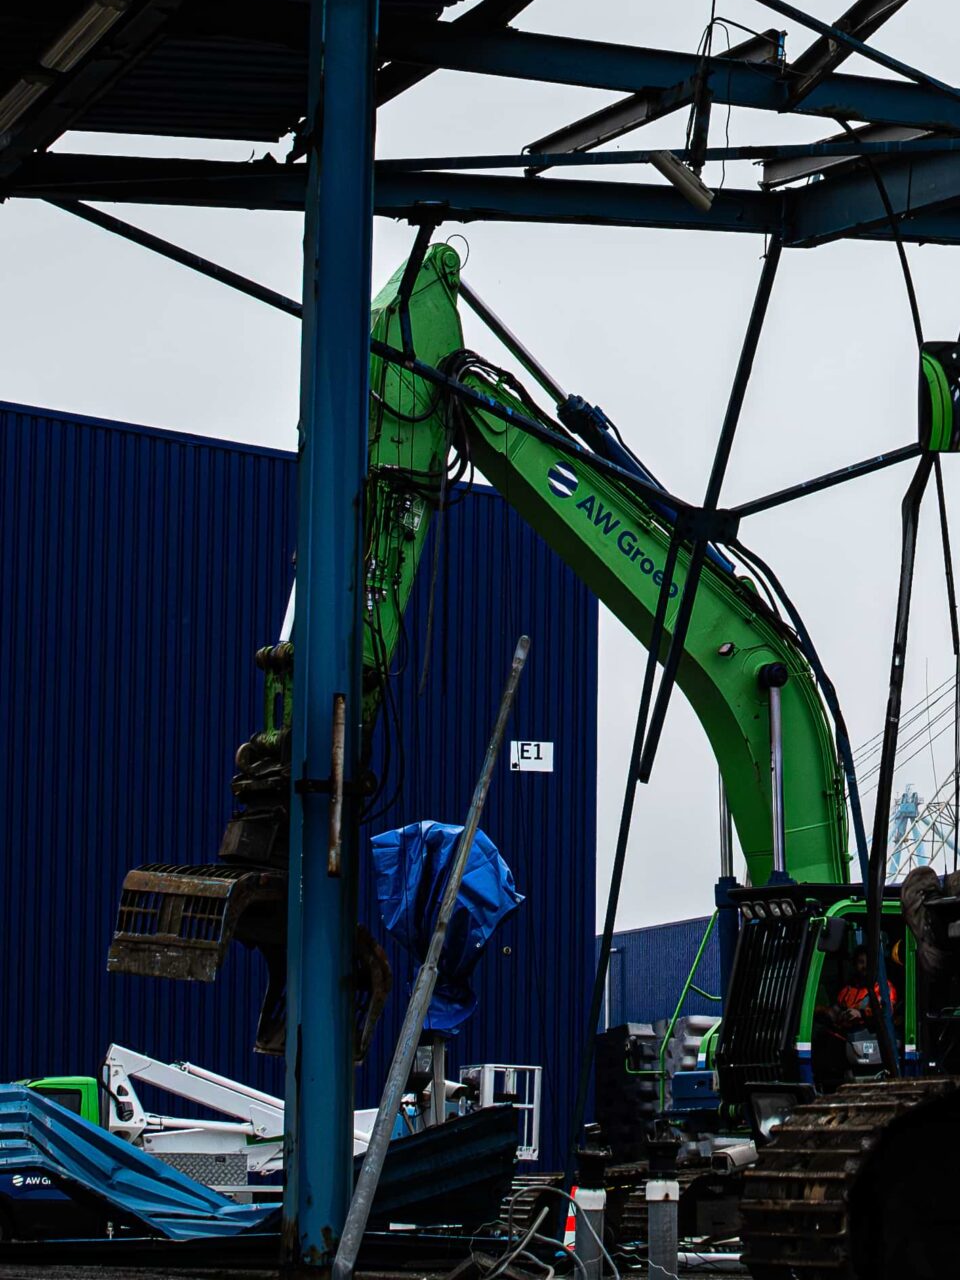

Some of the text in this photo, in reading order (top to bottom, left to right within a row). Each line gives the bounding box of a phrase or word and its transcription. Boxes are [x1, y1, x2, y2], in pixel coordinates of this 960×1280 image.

[576, 495, 620, 535] AW
[520, 743, 543, 760] E1
[25, 1176, 40, 1185] AW
